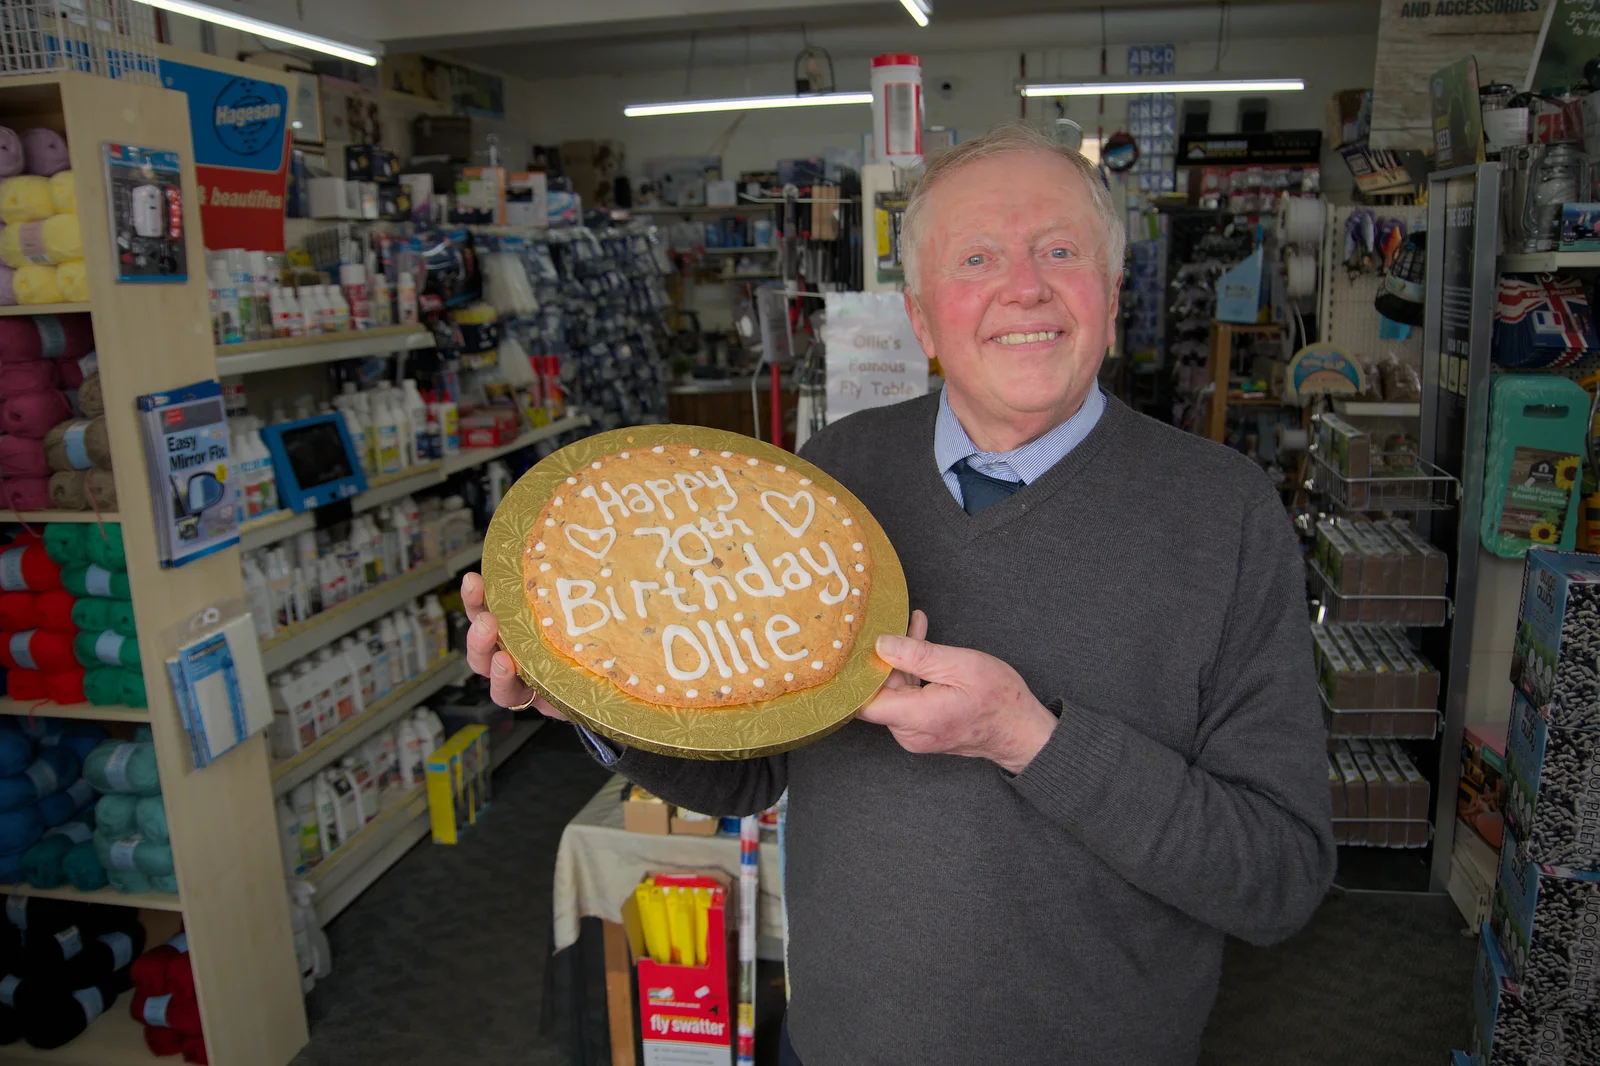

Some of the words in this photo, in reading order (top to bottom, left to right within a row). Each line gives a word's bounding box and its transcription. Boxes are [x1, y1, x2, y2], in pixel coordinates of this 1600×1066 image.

[1400, 2, 1431, 18] AND
[1435, 0, 1539, 16] ACCESSORIES
[215, 103, 281, 127] Hagesan
[210, 188, 282, 209] beautifies
[1457, 206, 1473, 227] BEST
[853, 334, 902, 350] Ollie's
[848, 358, 905, 374] Famous
[840, 379, 862, 400] Fly
[870, 381, 914, 396] Table
[166, 434, 197, 454] Easy
[169, 452, 206, 472] Mirror
[208, 444, 227, 462] Fix
[581, 465, 738, 525] Happy
[635, 512, 755, 569] 70th
[556, 541, 850, 636] Birthday
[1540, 568, 1557, 593] slugs
[1536, 584, 1556, 615] away
[661, 611, 809, 682] Ollie
[1577, 801, 1600, 856] PELLETS
[1580, 894, 1600, 945] WOOL
[1572, 949, 1594, 1002] PELLETS
[650, 1013, 671, 1036] fly
[671, 1018, 726, 1037] swatter
[1539, 1013, 1560, 1059] WOOL
